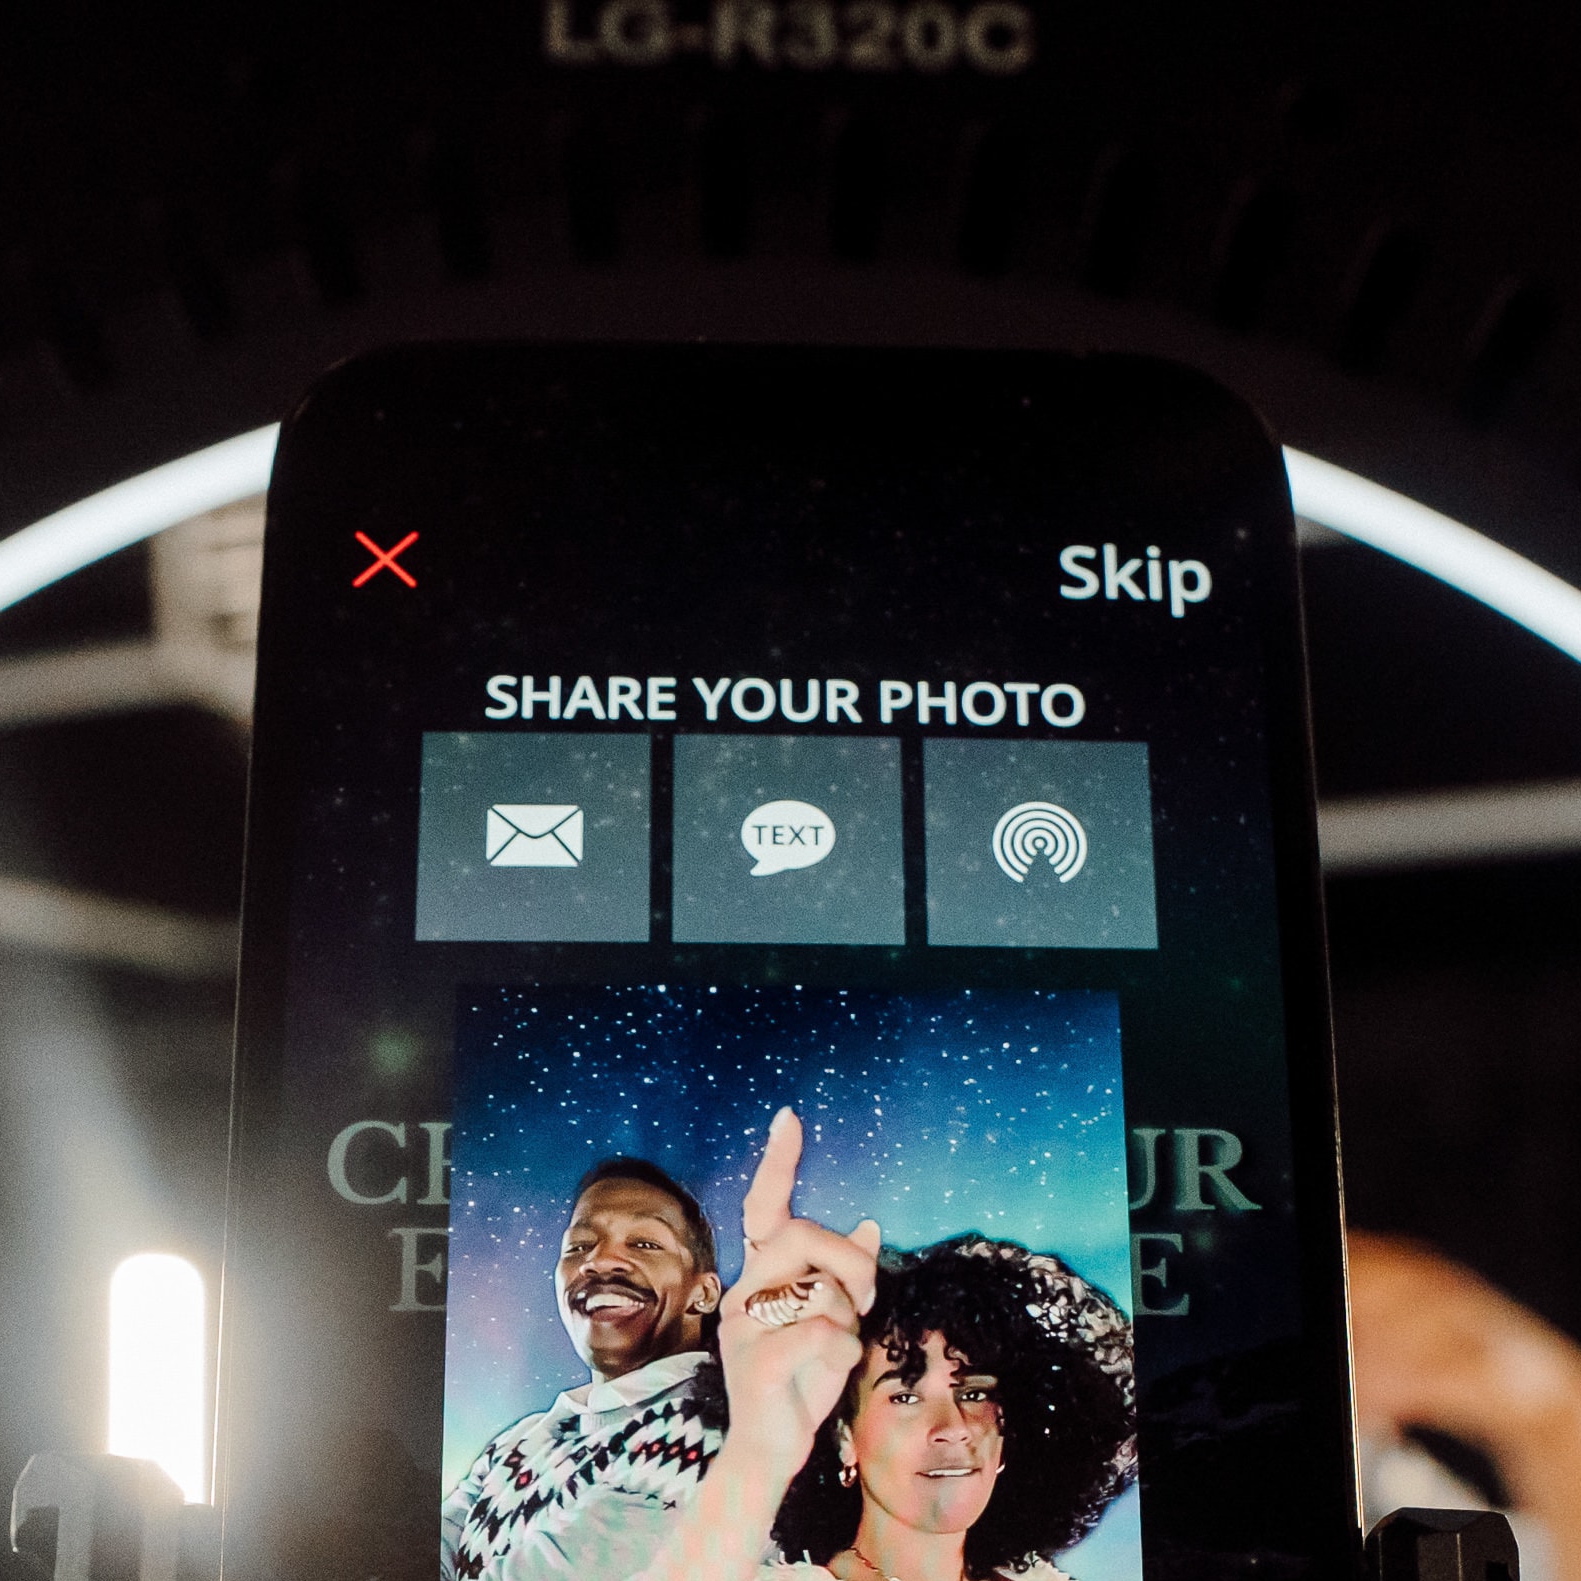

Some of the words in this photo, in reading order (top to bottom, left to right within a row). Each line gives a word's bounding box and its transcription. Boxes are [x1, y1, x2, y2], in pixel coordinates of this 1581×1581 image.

[542, 0, 1031, 71] LG-R320C
[1059, 542, 1213, 618] Skip
[485, 673, 677, 721] SHARE
[692, 676, 863, 724] YOUR
[879, 679, 1086, 728] PHOTO
[751, 821, 825, 848] TEXT
